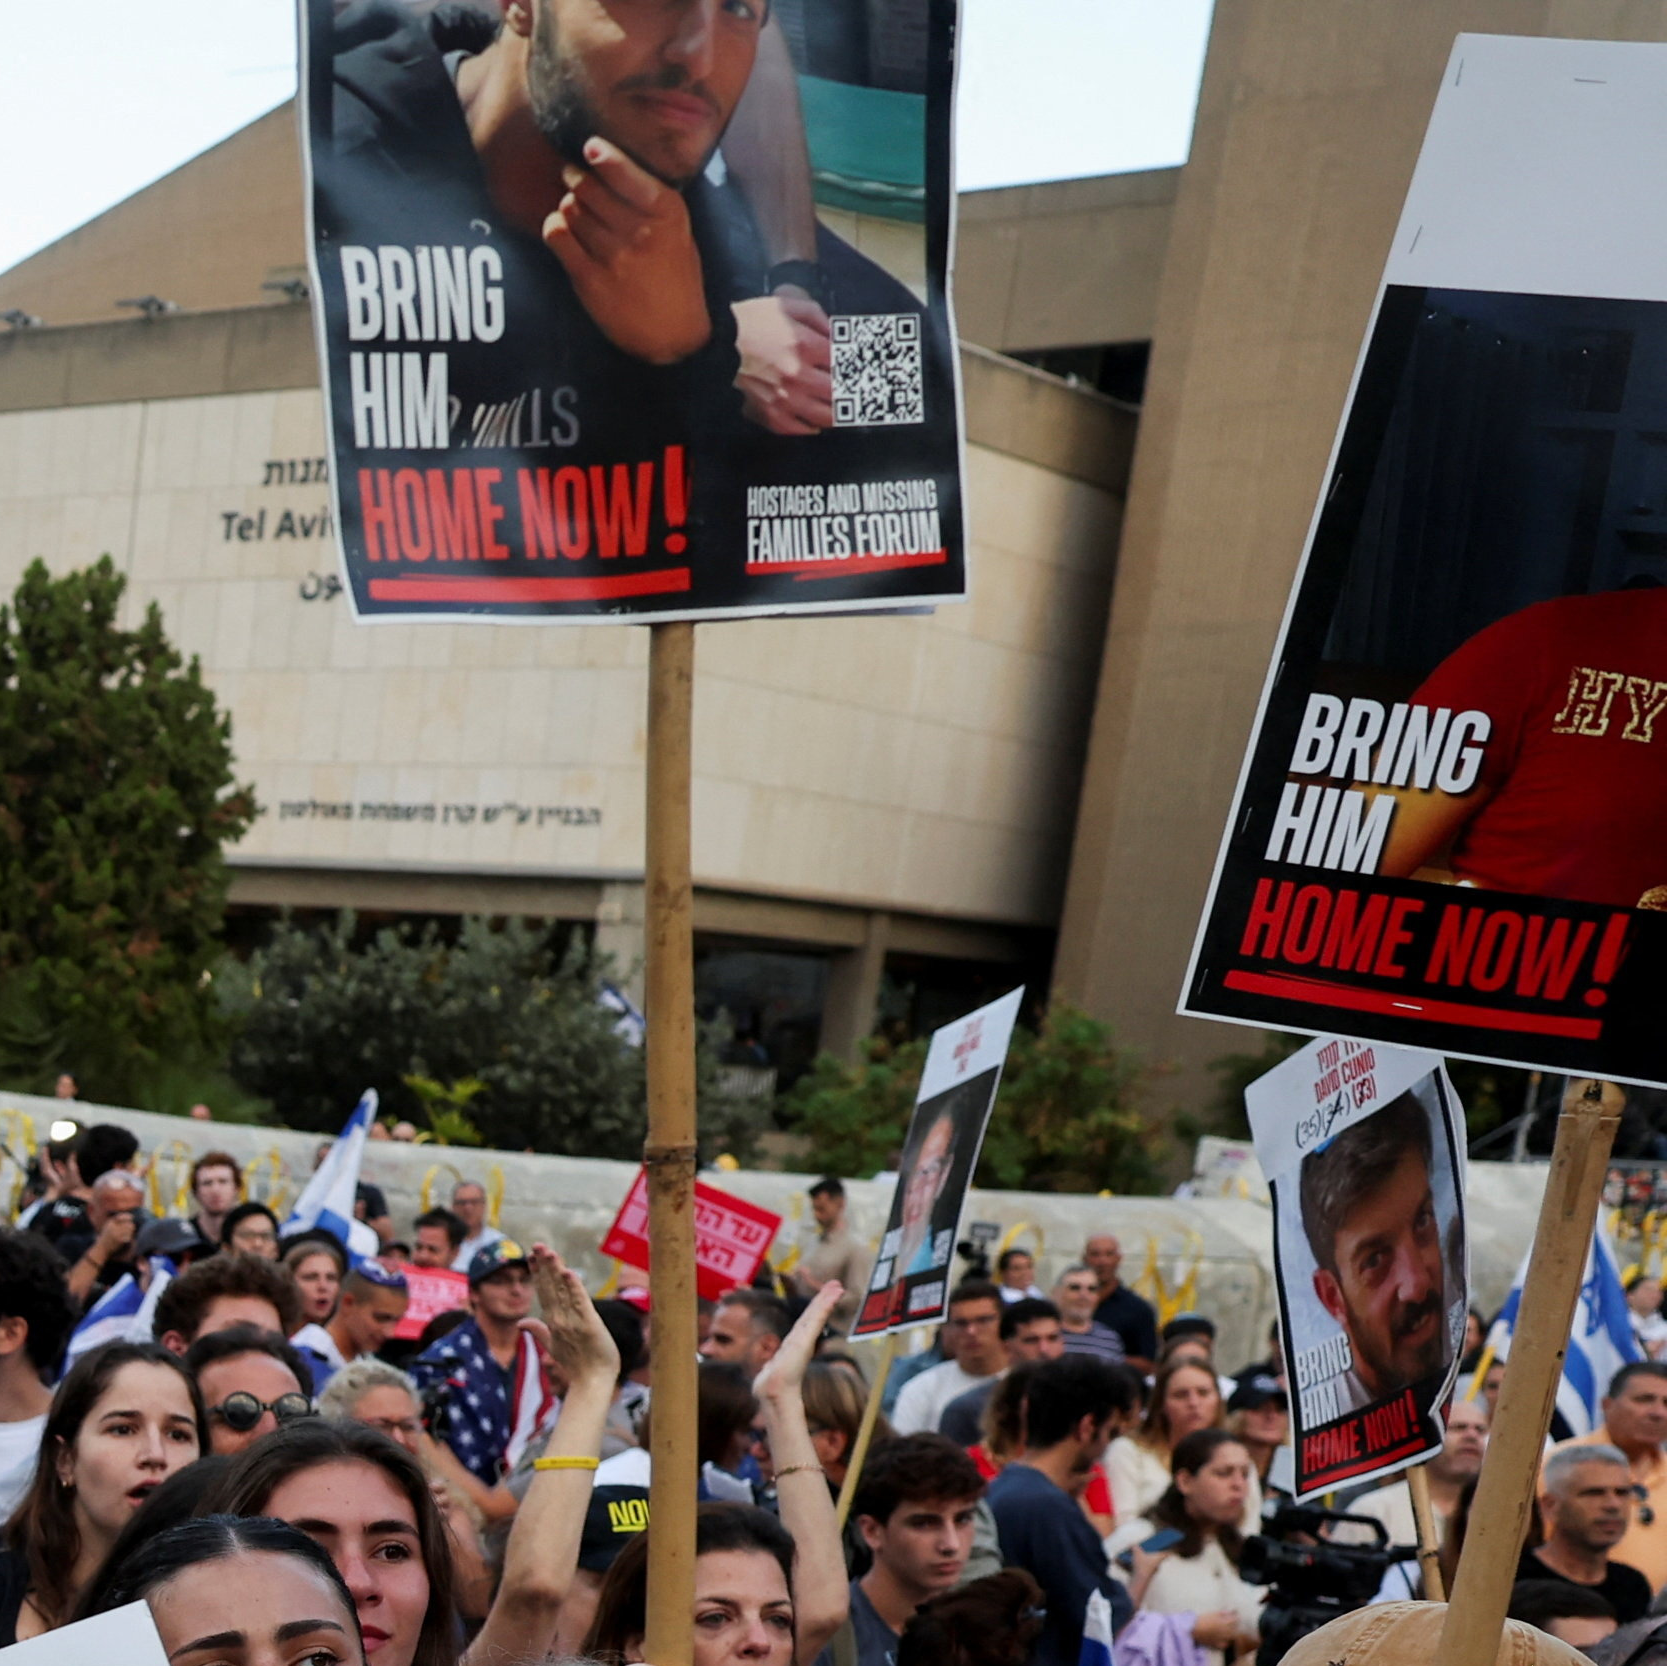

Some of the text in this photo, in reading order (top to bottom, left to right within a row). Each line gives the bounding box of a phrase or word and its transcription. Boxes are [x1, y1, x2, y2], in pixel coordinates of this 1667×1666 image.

[340, 245, 505, 344] BRING
[349, 352, 450, 450] HIM
[221, 508, 266, 542] Tel
[358, 445, 691, 563] HOME NOW!
[748, 480, 937, 519] HOSTAGES AND MISSING
[746, 509, 942, 564] FAMILIES FORUM
[1288, 693, 1491, 794] BRING
[1264, 782, 1397, 875] HIM
[1239, 877, 1631, 1007] HOME NOW!
[1314, 1069, 1341, 1104] DAVID
[1342, 1047, 1376, 1084] CUNIO
[1295, 1332, 1352, 1391] BRING
[1301, 1389, 1341, 1431] HIM
[1302, 1389, 1421, 1475] HOME NOW!
[608, 1499, 650, 1526] NO
